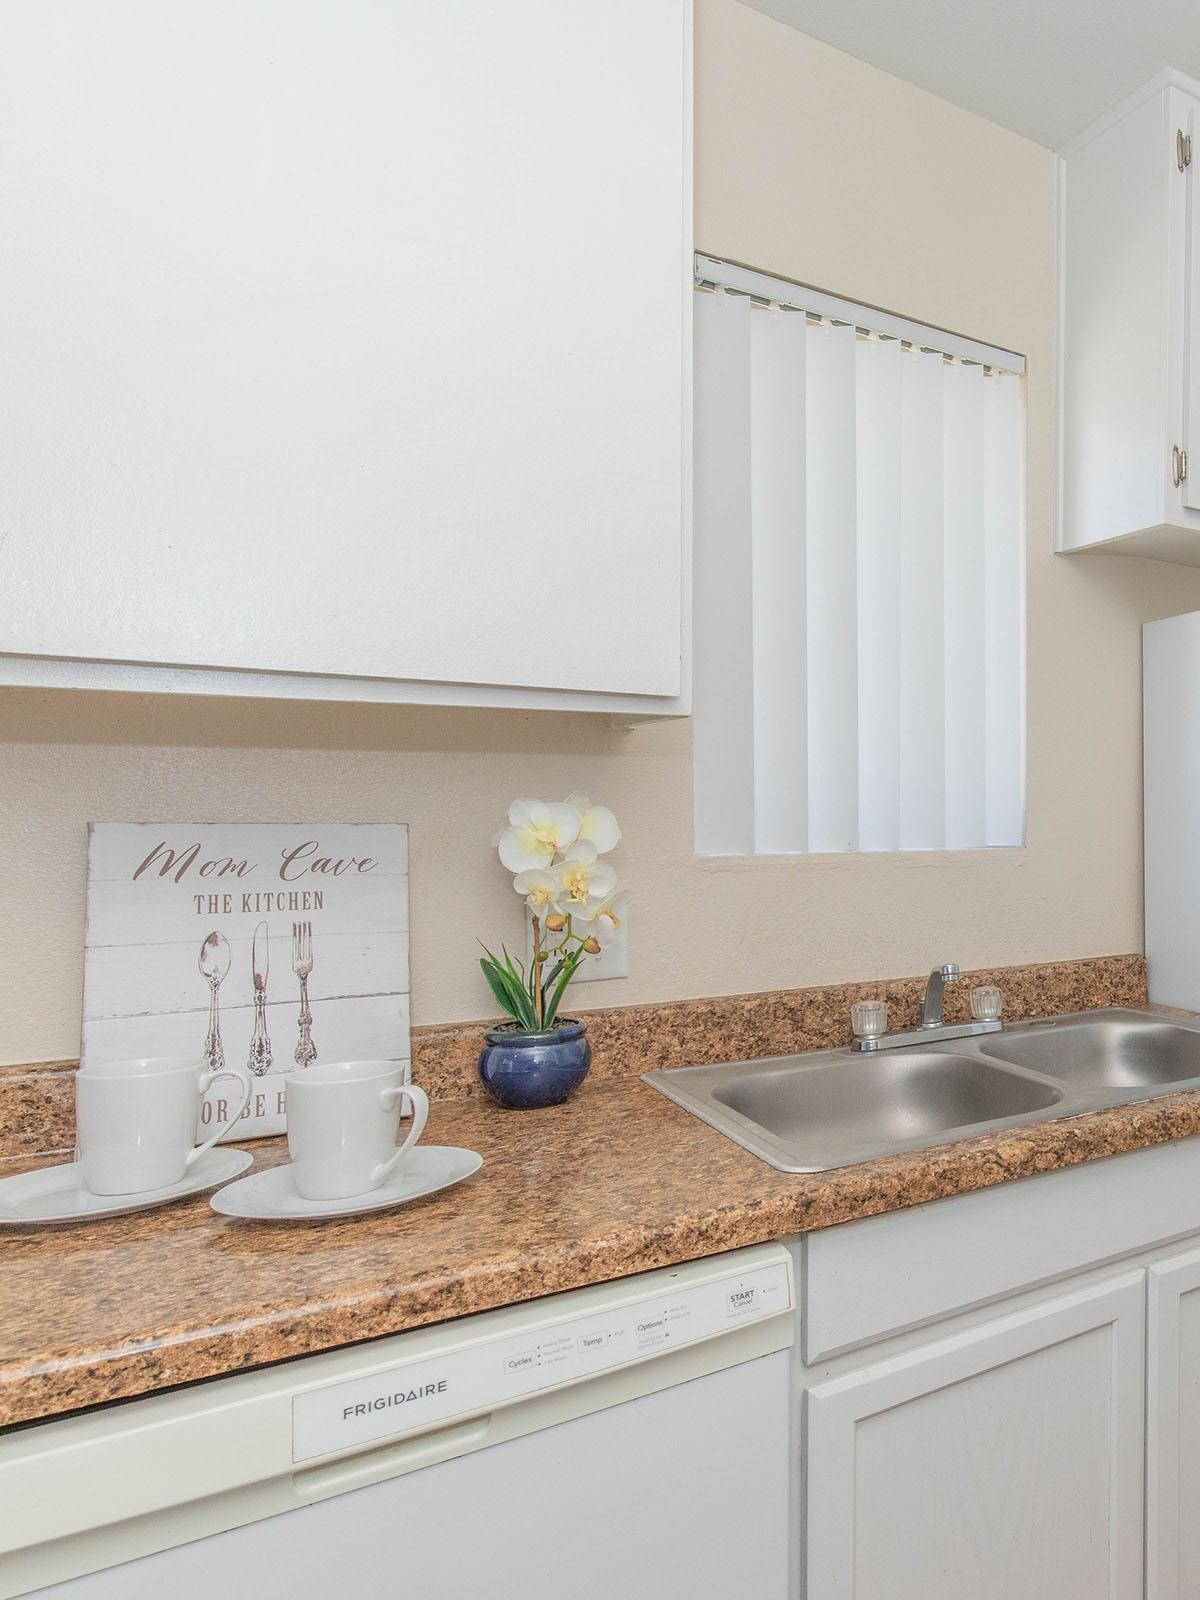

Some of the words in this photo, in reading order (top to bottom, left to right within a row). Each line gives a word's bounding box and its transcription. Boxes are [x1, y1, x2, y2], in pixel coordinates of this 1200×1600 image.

[132, 841, 258, 883] Mom
[278, 840, 379, 882] Cave
[193, 893, 232, 914] THE
[241, 890, 324, 913] KITCHEN
[201, 1099, 228, 1125] OR
[730, 1289, 755, 1303] START
[637, 1320, 663, 1332] Options
[583, 1337, 603, 1347] Temp
[508, 1356, 532, 1369] Cycles
[343, 1380, 448, 1420] FRIGIDAIRE
